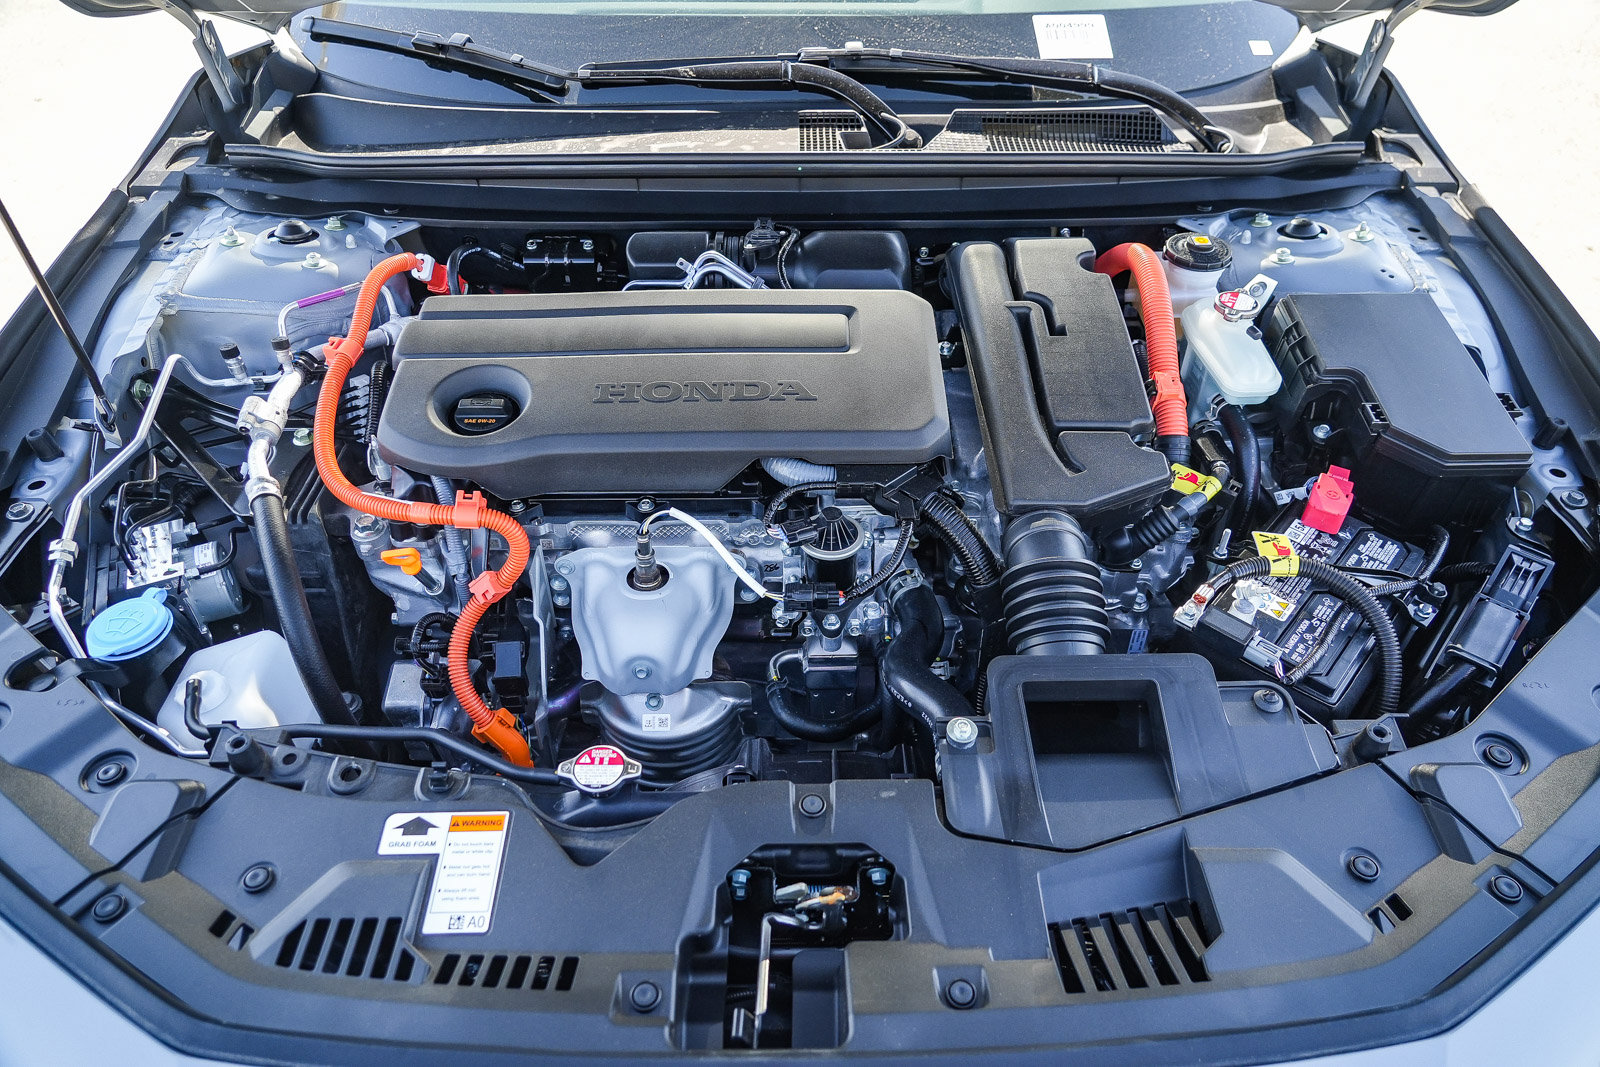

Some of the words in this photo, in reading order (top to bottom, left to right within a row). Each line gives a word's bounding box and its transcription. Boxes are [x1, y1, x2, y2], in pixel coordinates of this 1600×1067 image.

[593, 380, 818, 403] HONDA
[461, 819, 502, 827] WARNING
[466, 915, 486, 929] A0
